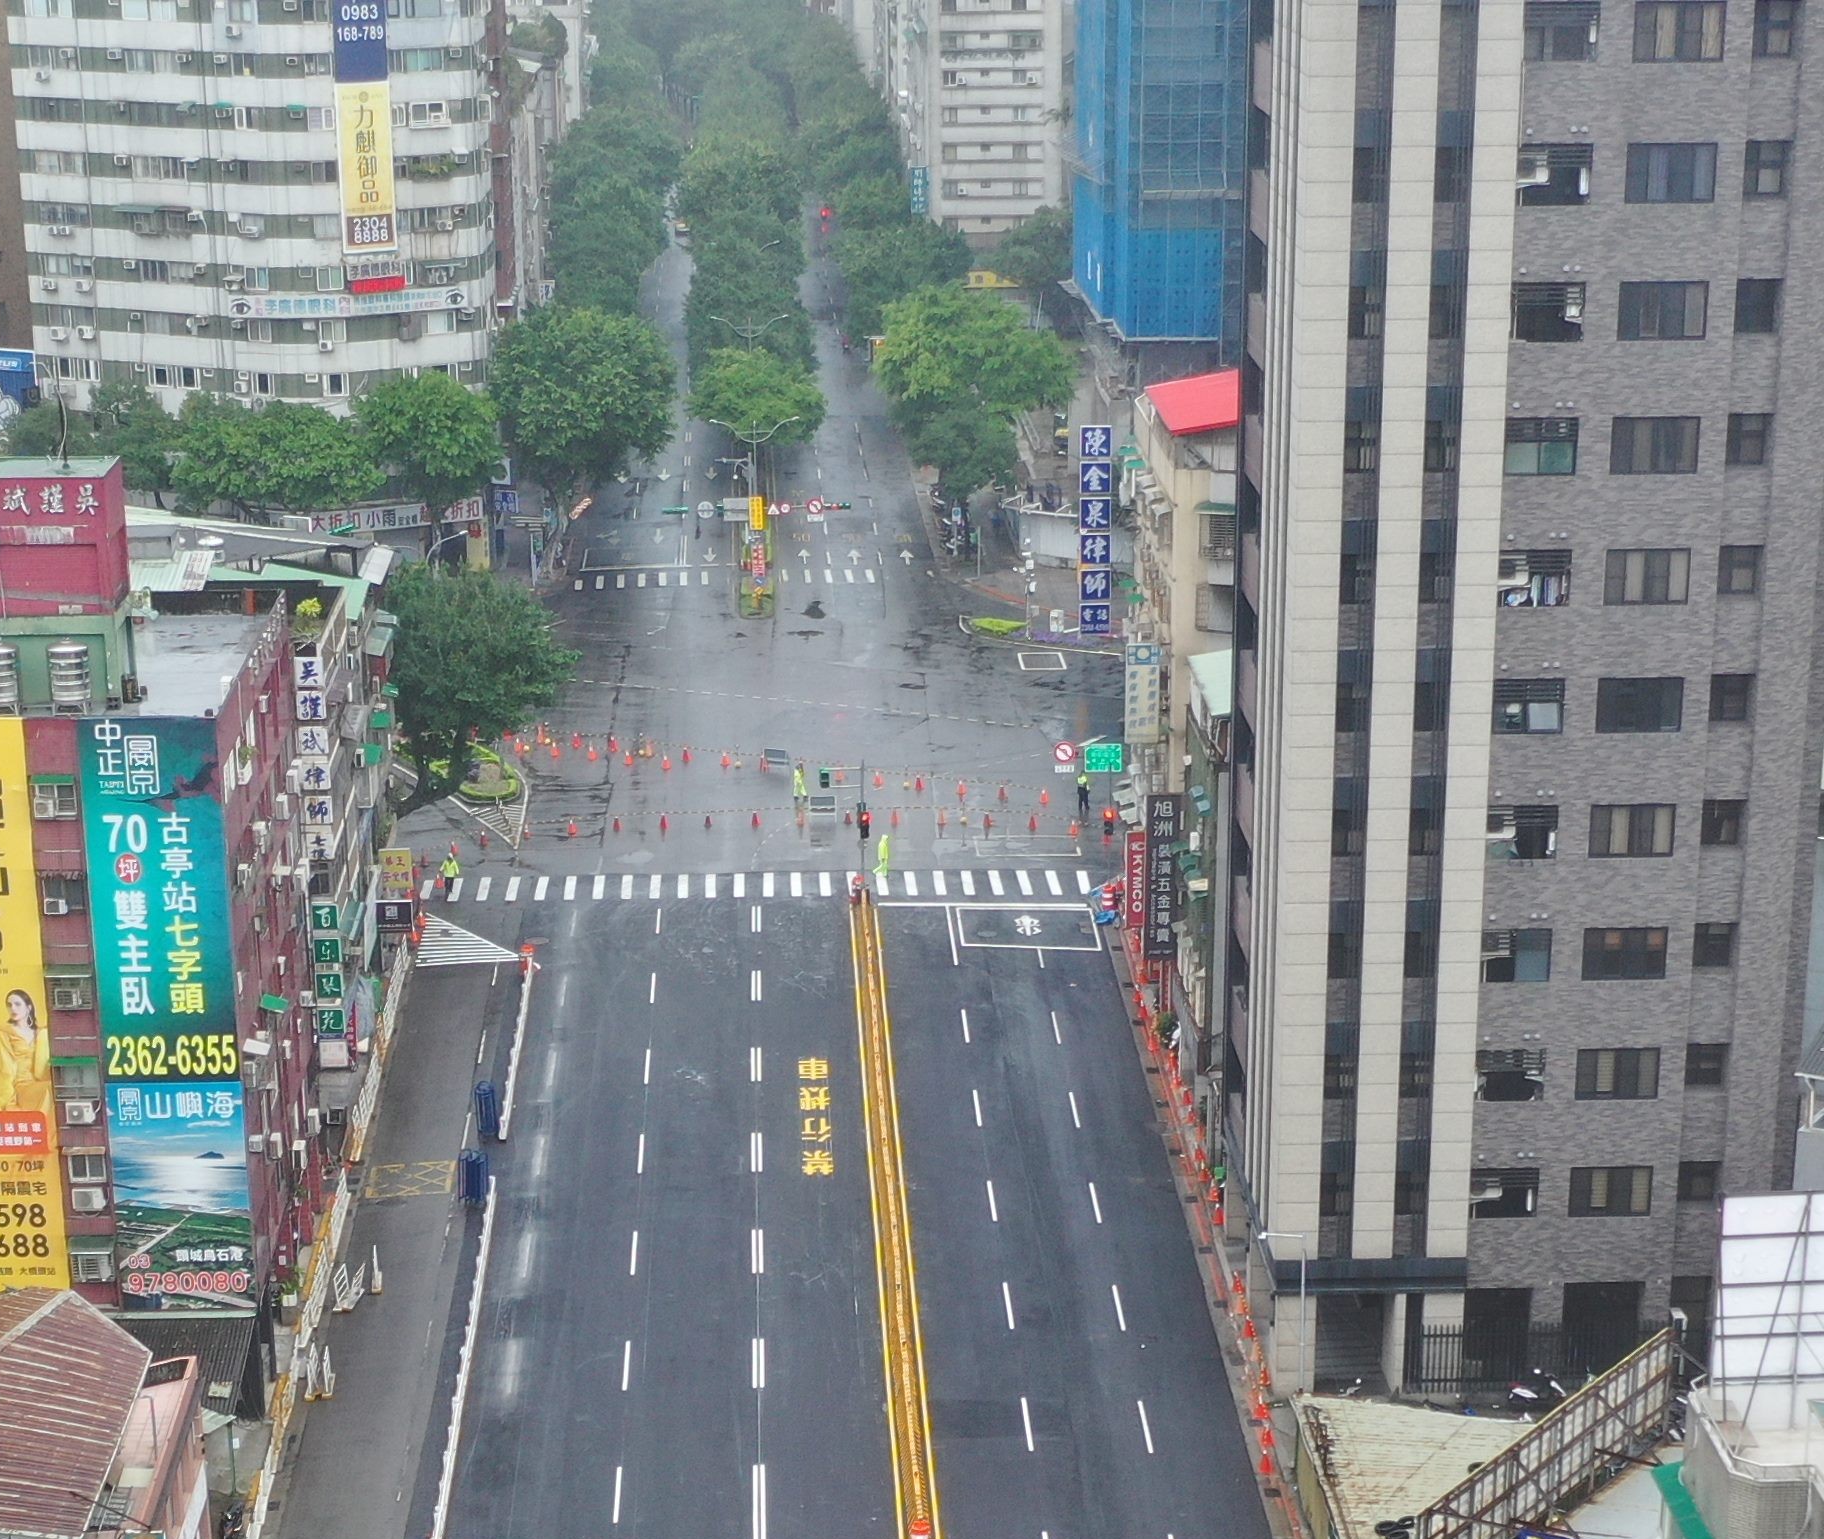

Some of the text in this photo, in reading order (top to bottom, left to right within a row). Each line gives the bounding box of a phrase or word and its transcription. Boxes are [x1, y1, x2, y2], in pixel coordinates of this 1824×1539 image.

[341, 4, 378, 20] 0983
[337, 25, 383, 42] 168-789
[353, 216, 388, 231] 2304
[354, 229, 388, 243] 8888
[366, 510, 396, 529] 小雨
[1084, 428, 1108, 598] 陳金泉律師
[94, 719, 124, 776] 中正
[1154, 801, 1173, 837] 旭洲
[1132, 854, 1143, 913] KYMCO
[106, 1035, 237, 1076] 2362-6355
[128, 1271, 248, 1294] 9780080
